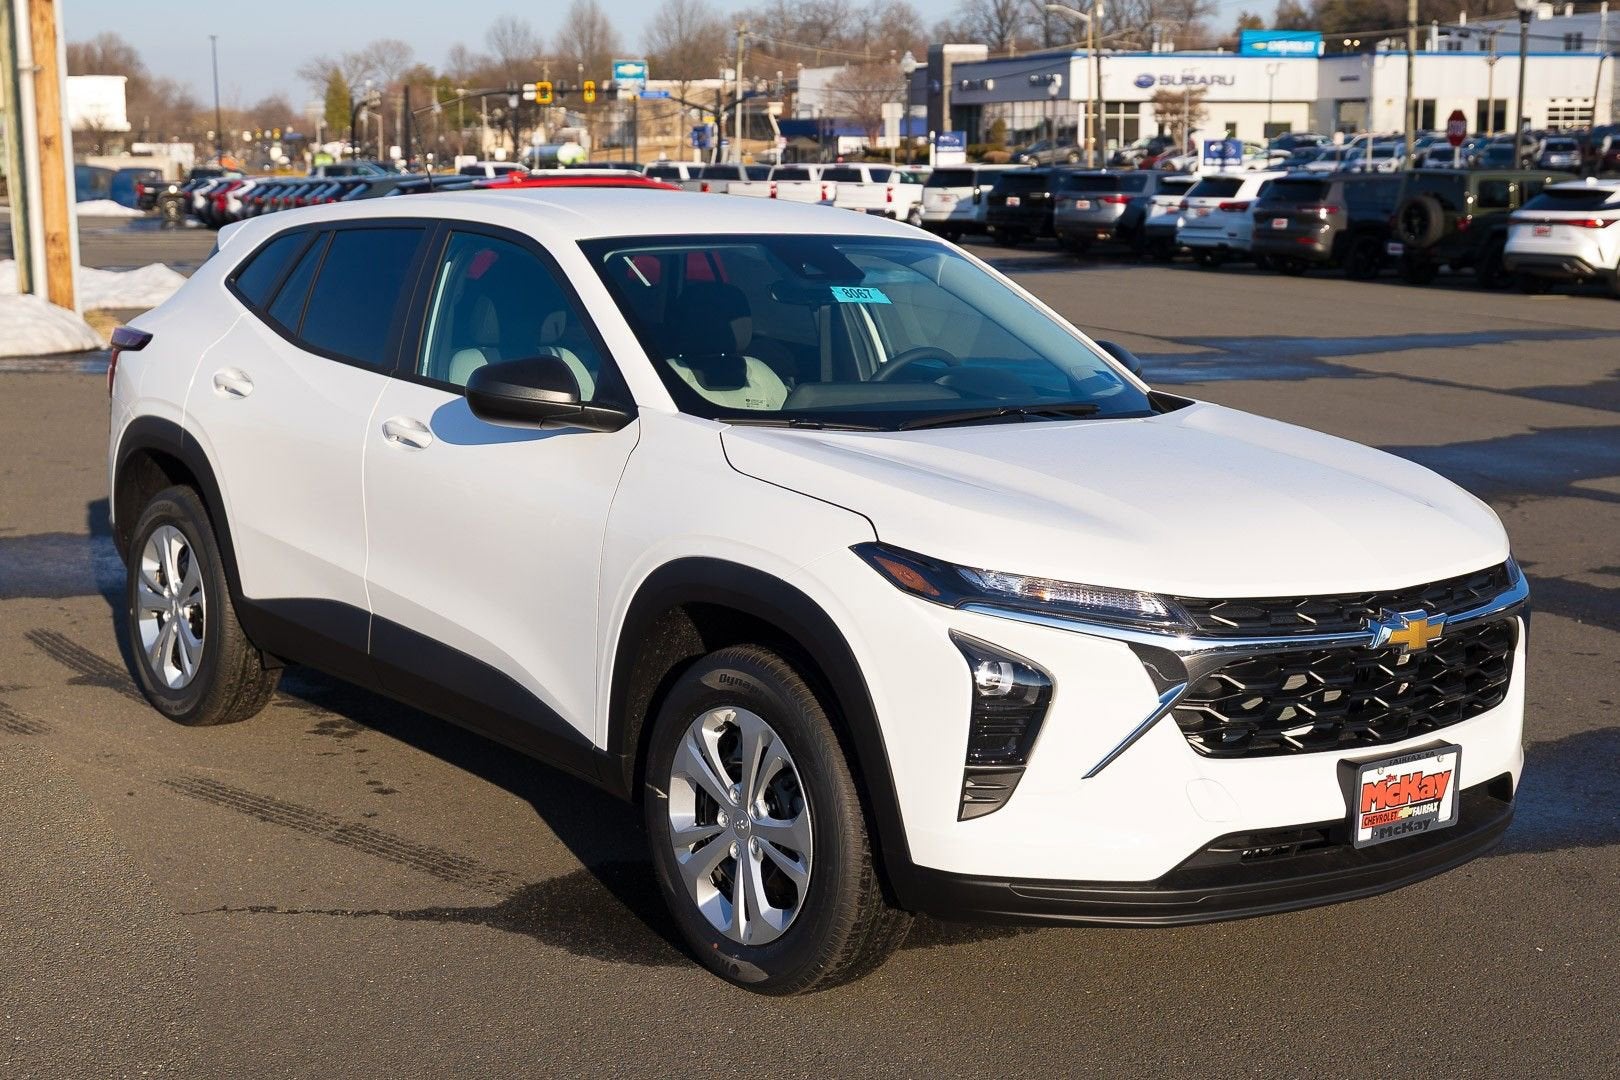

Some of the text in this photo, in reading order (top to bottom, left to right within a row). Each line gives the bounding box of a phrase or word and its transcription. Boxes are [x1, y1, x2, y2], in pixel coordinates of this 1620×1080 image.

[1159, 74, 1235, 86] SUBARU
[841, 288, 873, 299] 8067
[718, 673, 757, 692] Dyna
[1361, 770, 1451, 813] McKay
[1363, 811, 1398, 827] CHEVROLET
[1379, 818, 1432, 839] McKay
